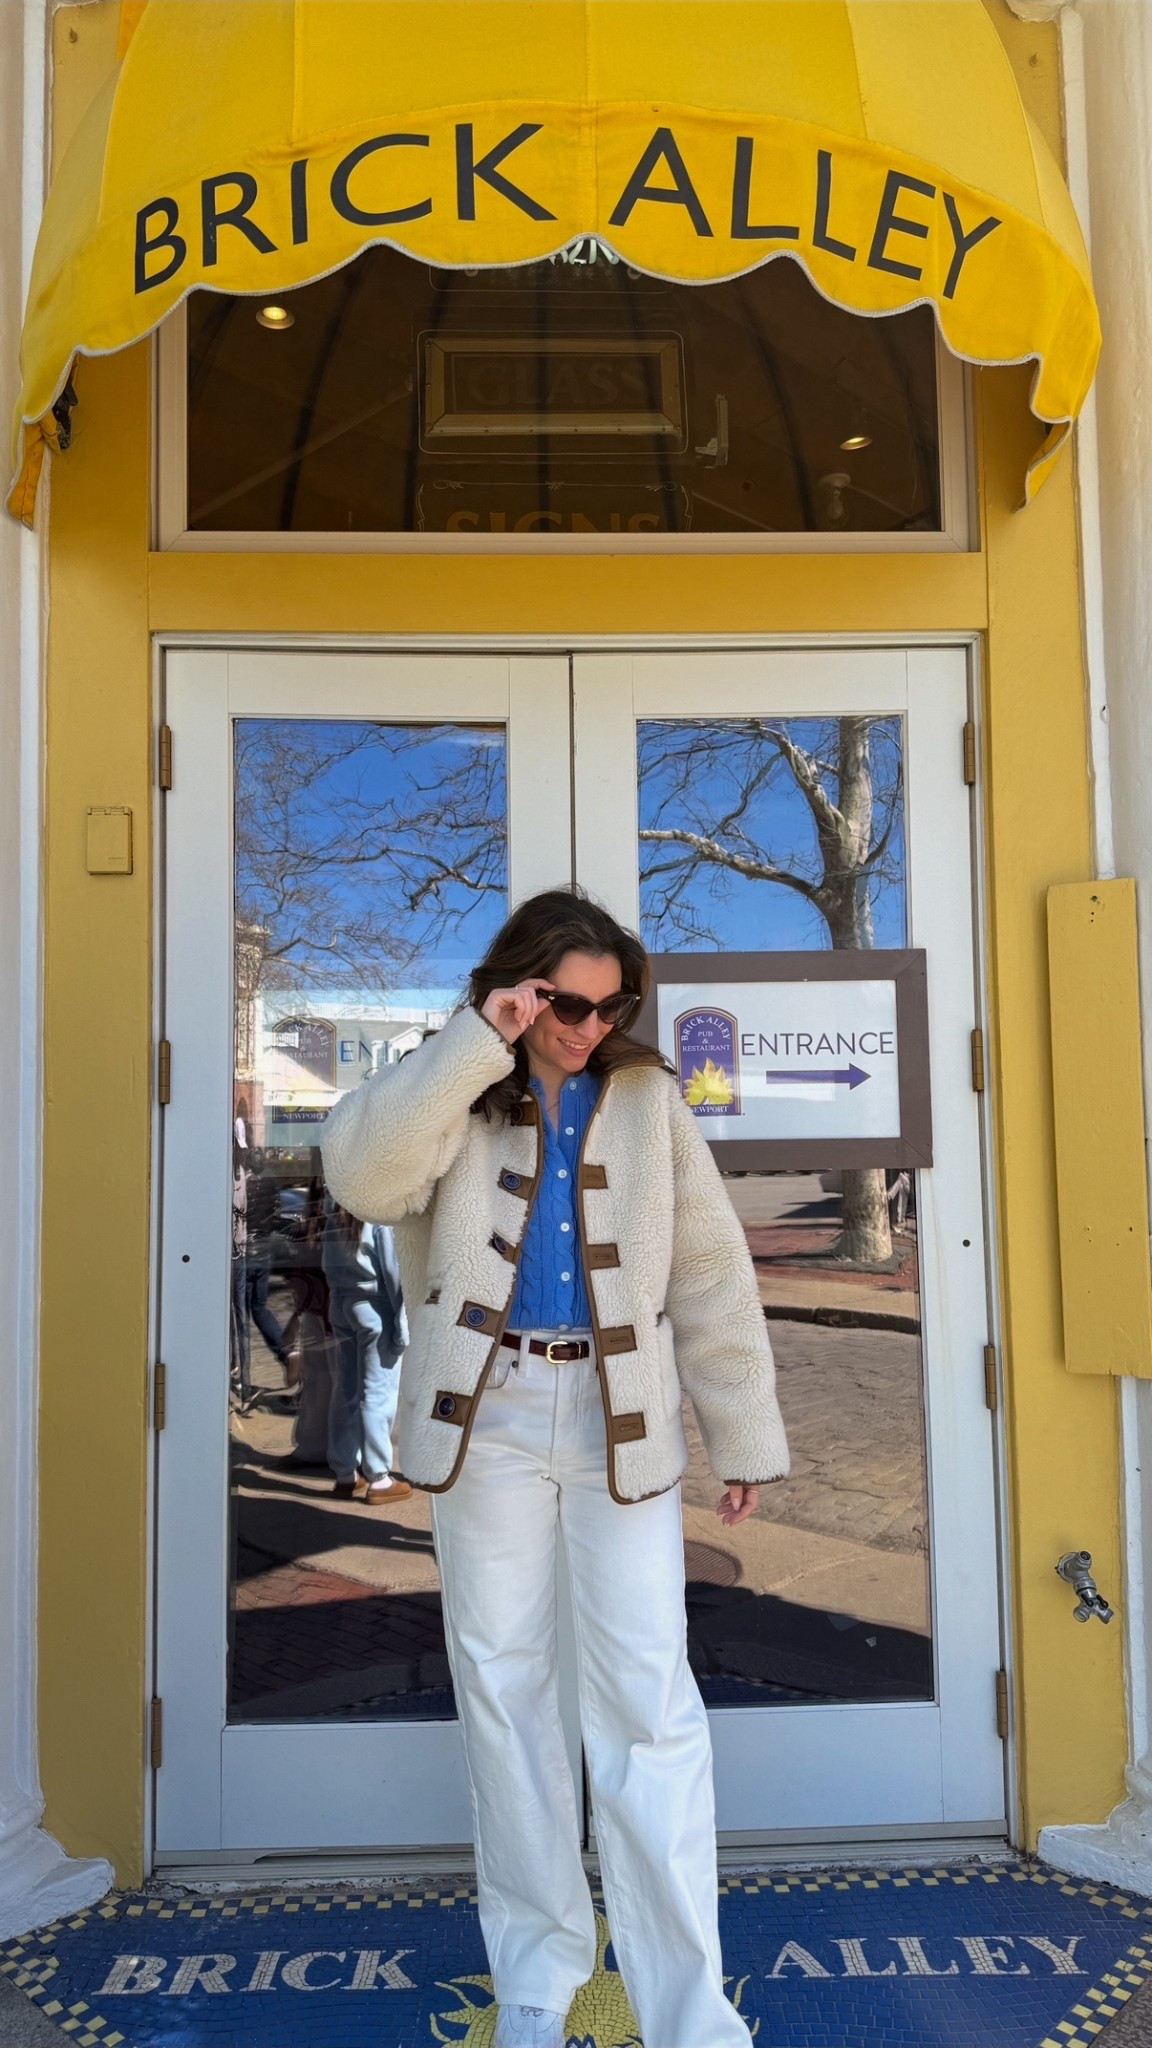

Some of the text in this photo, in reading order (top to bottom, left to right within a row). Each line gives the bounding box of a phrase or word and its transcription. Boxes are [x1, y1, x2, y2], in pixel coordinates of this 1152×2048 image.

[134, 122, 1003, 300] BRICK ALLEY
[681, 1015, 731, 1041] BRICK ALLEY
[682, 1044, 731, 1052] RESTAURANT
[741, 1031, 895, 1056] ENTRANCE
[91, 1935, 1090, 1996] BRICK ALLEY
